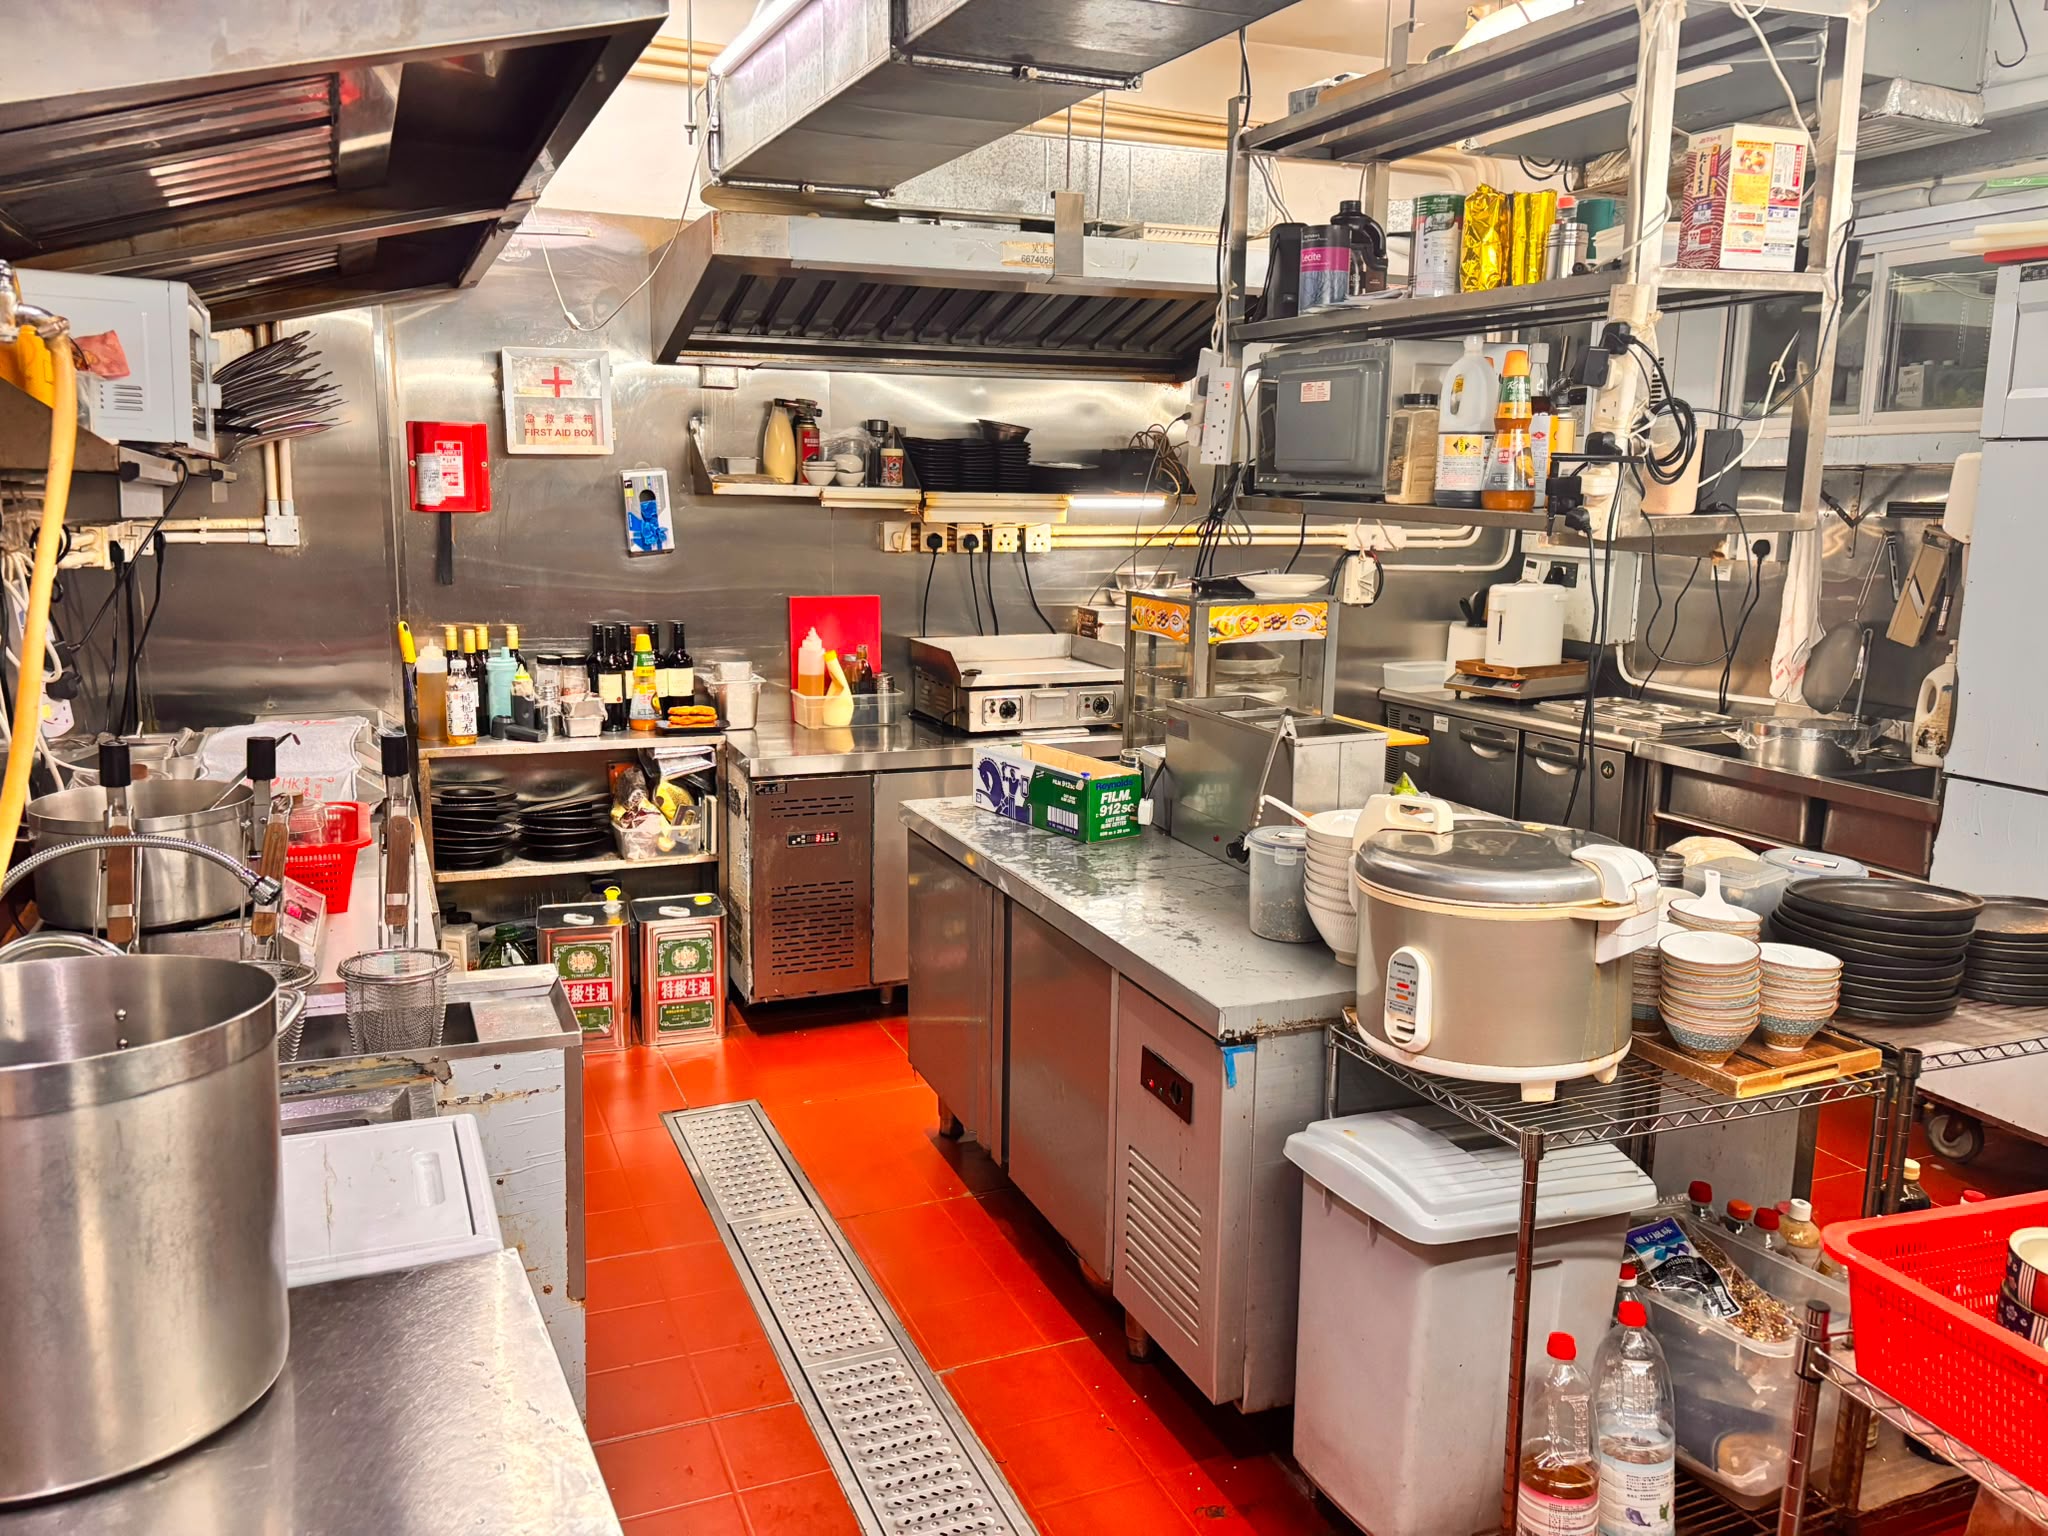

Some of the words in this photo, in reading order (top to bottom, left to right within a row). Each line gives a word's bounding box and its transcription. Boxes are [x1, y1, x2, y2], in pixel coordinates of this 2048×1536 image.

[524, 428, 553, 437] FIRST
[554, 428, 572, 437] AID
[574, 428, 595, 437] BOX
[1096, 780, 1133, 790] Reynolds
[661, 977, 711, 999] 特級生油
